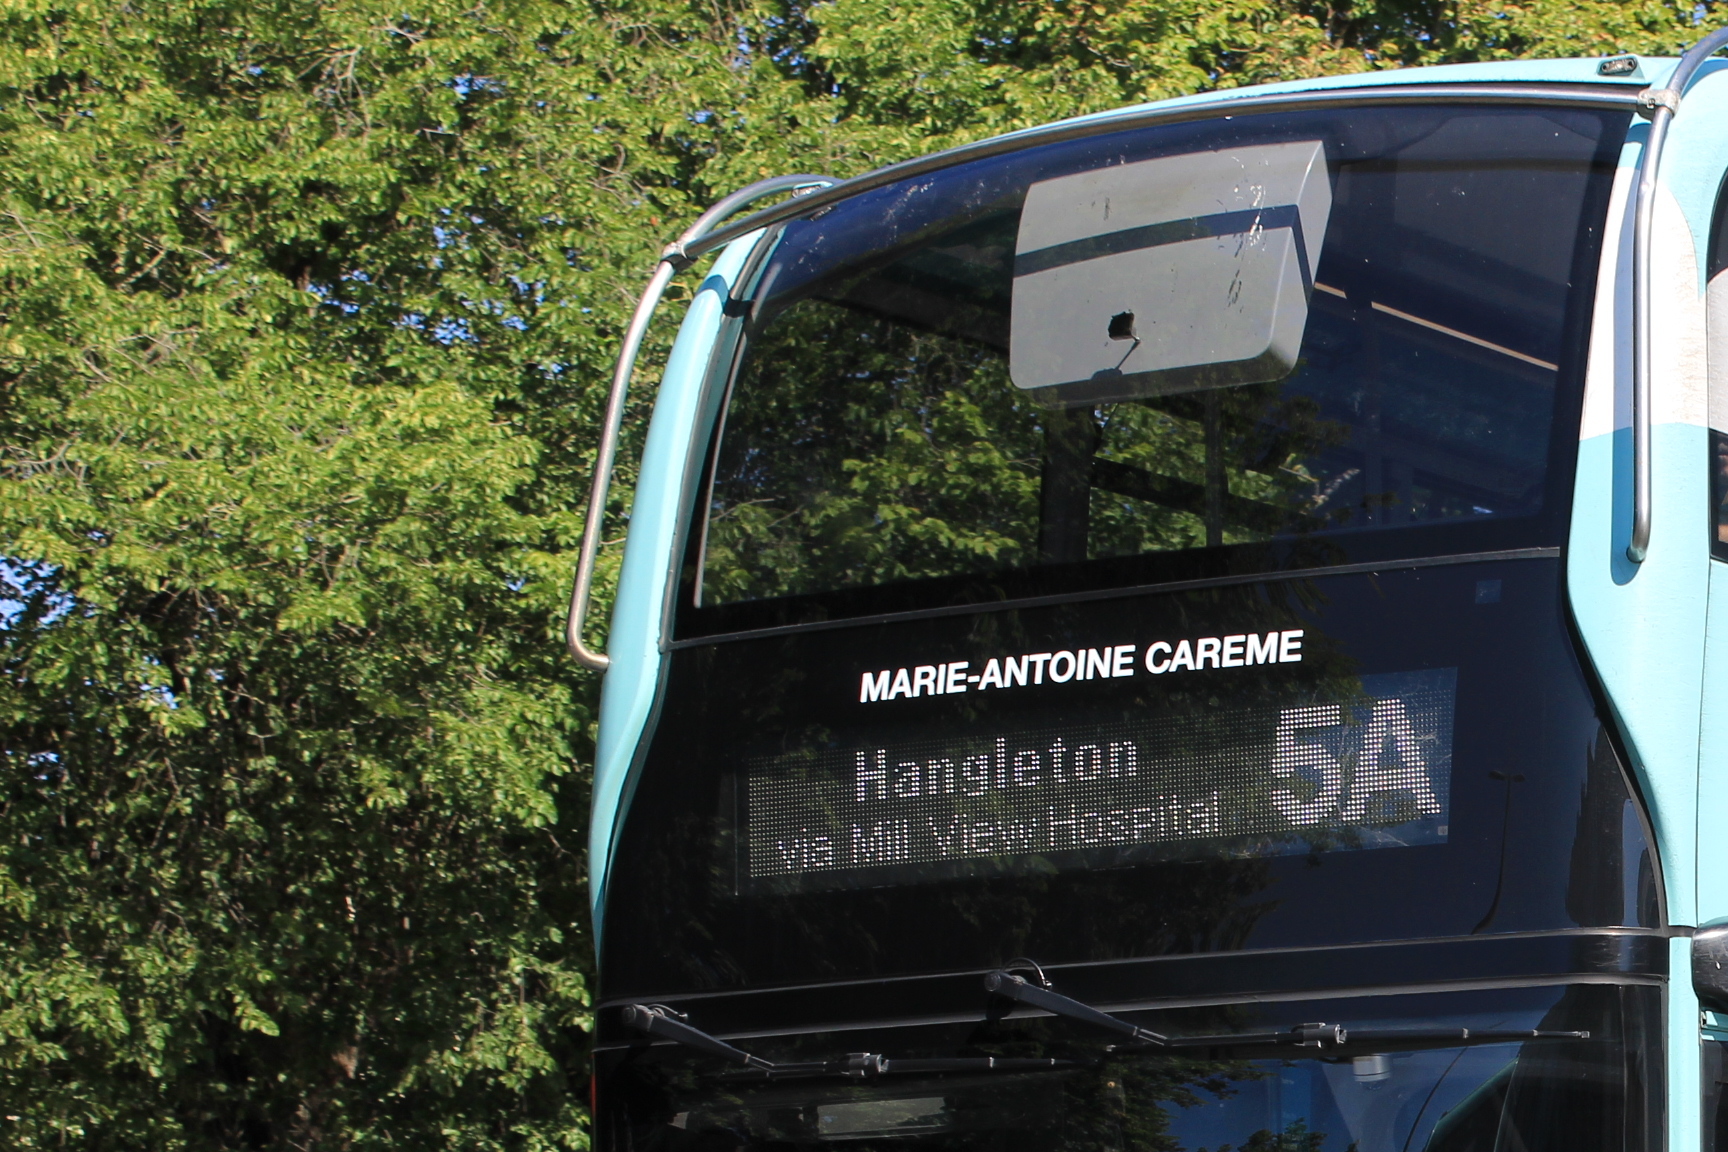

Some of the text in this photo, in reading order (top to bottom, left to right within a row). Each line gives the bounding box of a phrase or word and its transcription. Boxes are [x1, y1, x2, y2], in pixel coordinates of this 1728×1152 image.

[859, 629, 1303, 703] MARIE-ANTOINE CAREME
[855, 736, 1138, 803] Hangleton
[1271, 698, 1441, 826] 5A
[778, 790, 1220, 872] via Mill View Hospital
